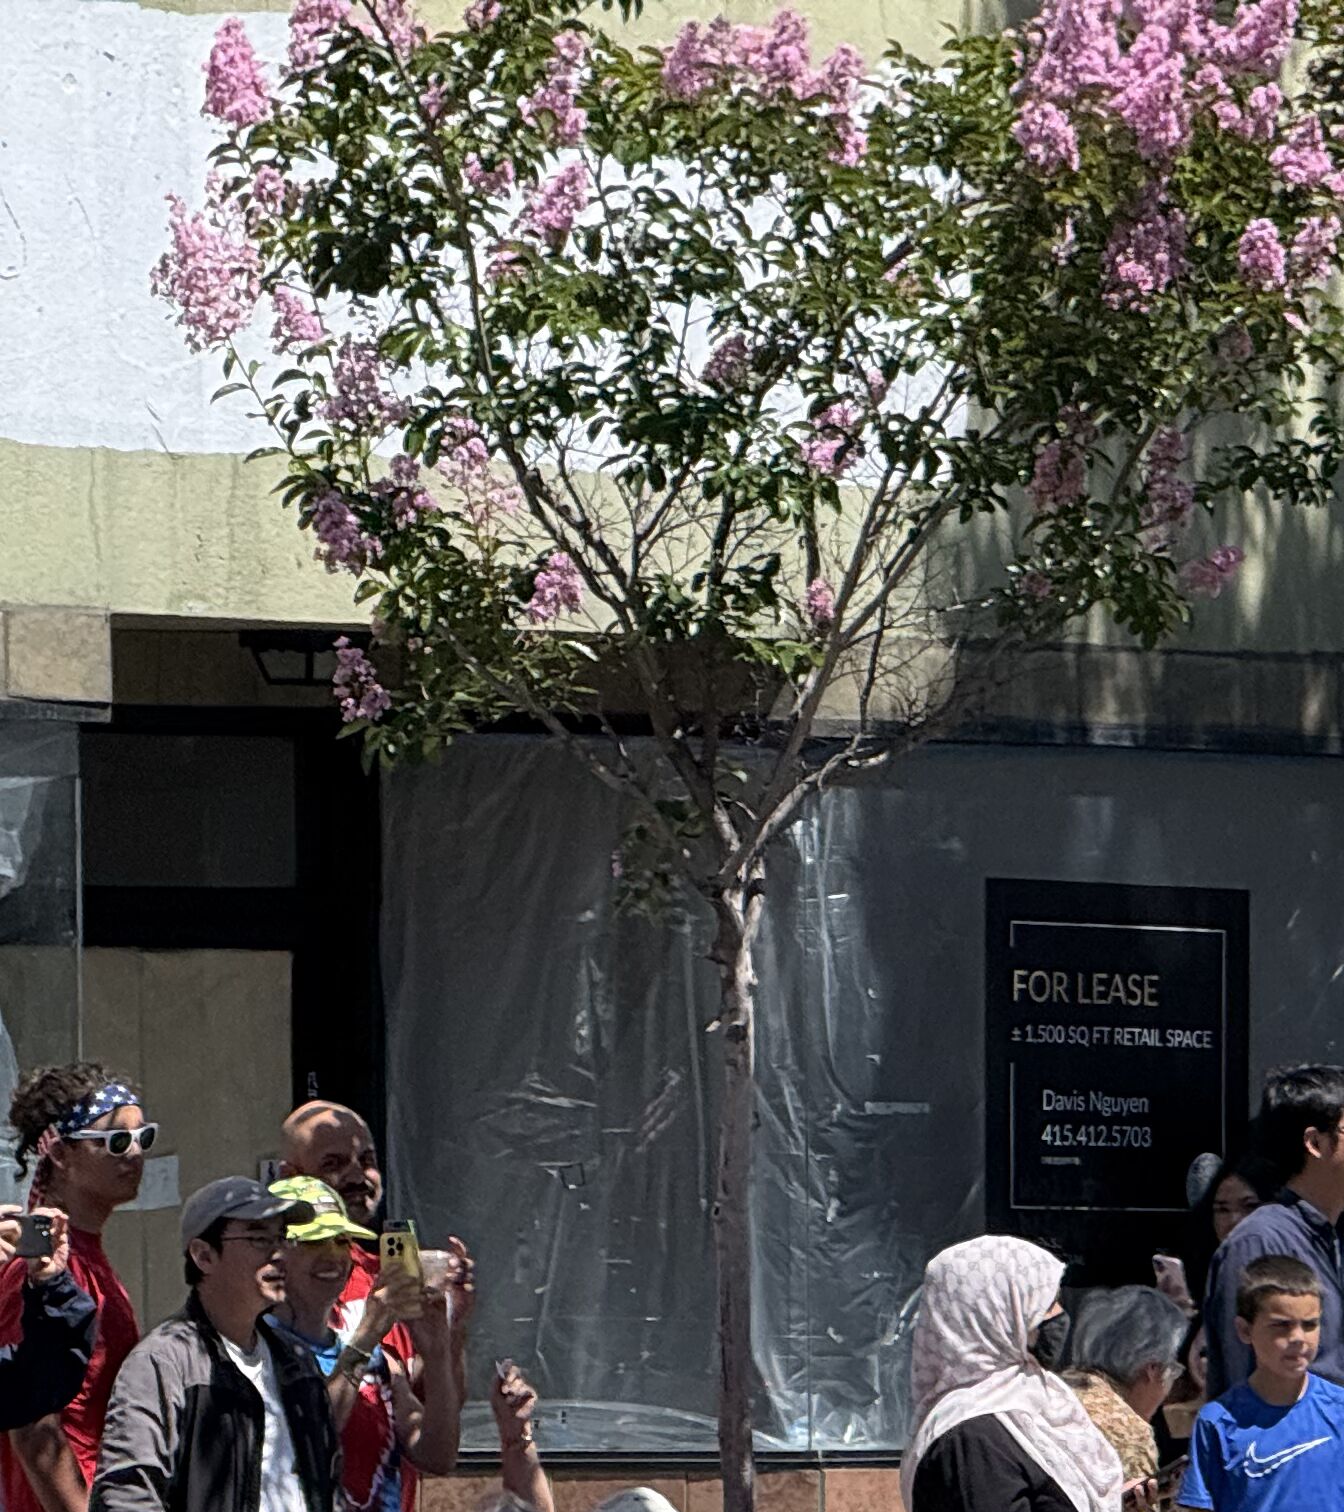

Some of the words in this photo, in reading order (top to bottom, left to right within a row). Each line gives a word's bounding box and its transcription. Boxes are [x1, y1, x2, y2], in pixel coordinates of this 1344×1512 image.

[1012, 970, 1069, 1004] FOR
[1077, 973, 1160, 1007] LEASE
[1066, 1026, 1090, 1049] SQ
[1092, 1027, 1111, 1045] FT
[1113, 1028, 1164, 1047] RETAIL
[1165, 1029, 1213, 1049] SPACE
[1042, 1089, 1085, 1113] Davis
[1089, 1090, 1150, 1118] Nguyen
[1040, 1123, 1152, 1148] 415.412.5703
